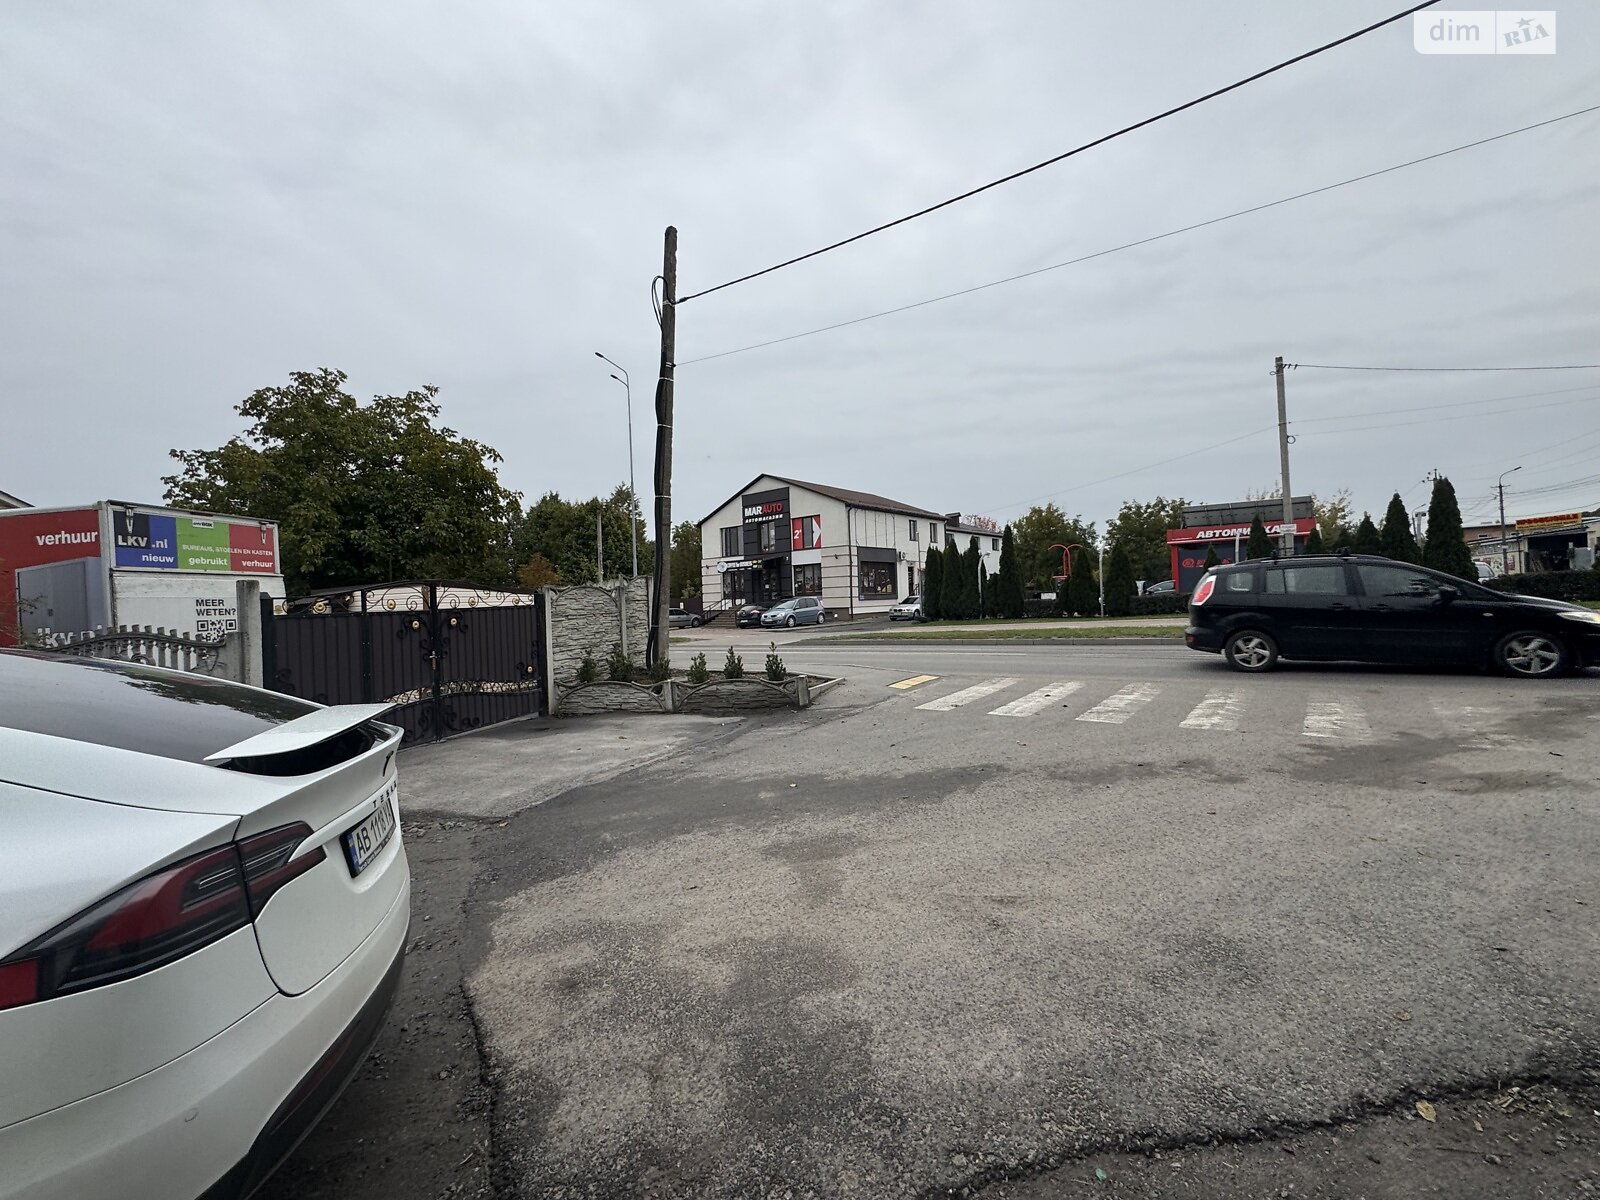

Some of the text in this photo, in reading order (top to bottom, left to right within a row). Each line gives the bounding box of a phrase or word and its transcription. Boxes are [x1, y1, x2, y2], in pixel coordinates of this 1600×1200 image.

[744, 503, 783, 517] MARAUTO
[1196, 524, 1282, 539] АВТОМИКА
[35, 530, 98, 546] verhuur
[141, 553, 174, 563] nieuw
[188, 556, 228, 567] gebruikt
[241, 559, 274, 568] verhuur
[195, 599, 225, 607] MEER
[195, 608, 237, 616] WETEN?
[355, 826, 372, 859] AB
